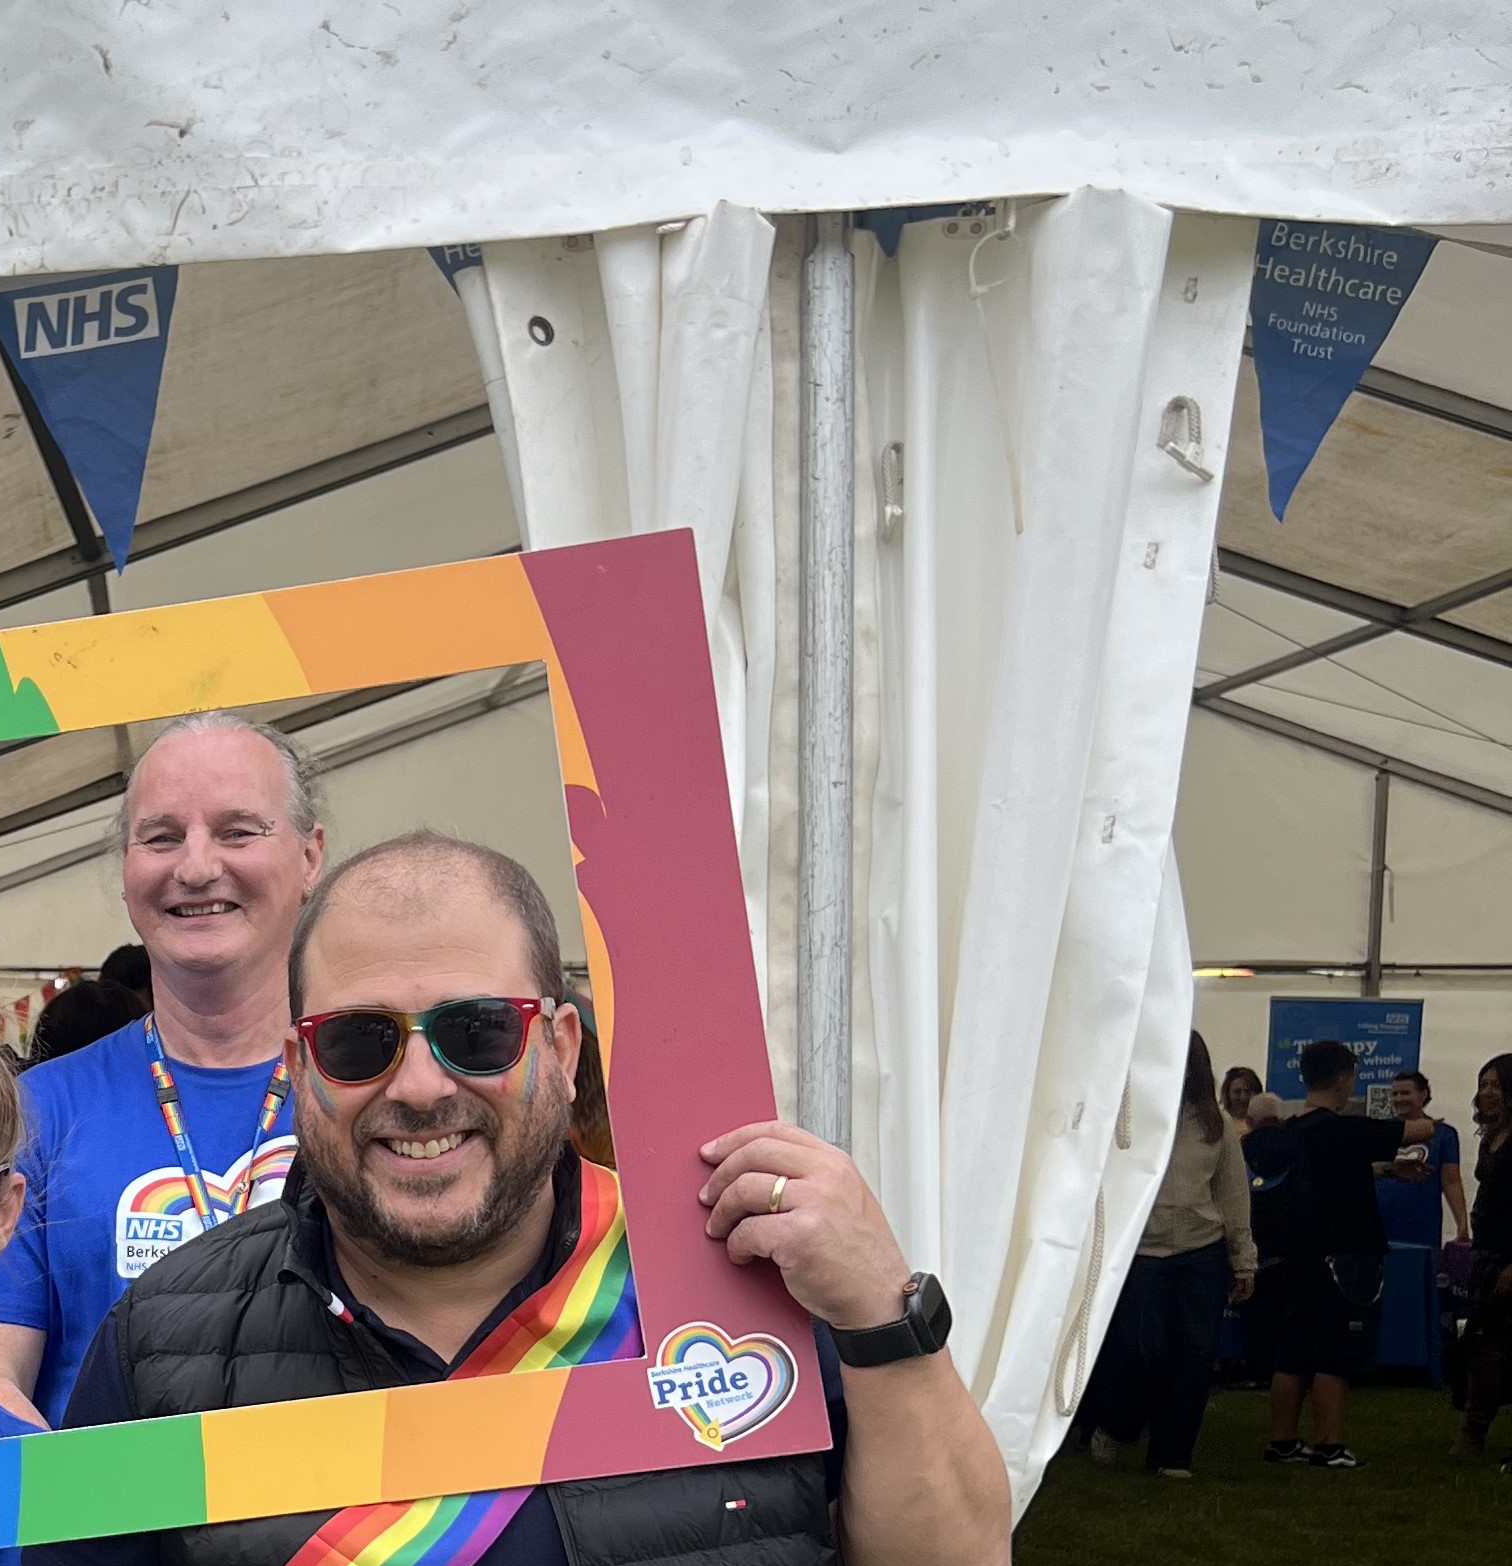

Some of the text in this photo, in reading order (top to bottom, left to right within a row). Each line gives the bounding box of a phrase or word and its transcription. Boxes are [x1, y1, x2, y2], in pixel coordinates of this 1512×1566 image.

[1271, 222, 1398, 270] Berkshire
[1255, 254, 1403, 305] Healthcare
[24, 283, 150, 354] NHS
[1303, 301, 1338, 321] NHS
[1268, 313, 1366, 345] Foundation
[1291, 339, 1333, 360] Trust
[1378, 1069, 1396, 1079] lif
[127, 1219, 180, 1239] NHS
[126, 1245, 171, 1258] Berks
[653, 1367, 749, 1405] Pride
[706, 1391, 753, 1408] Network
